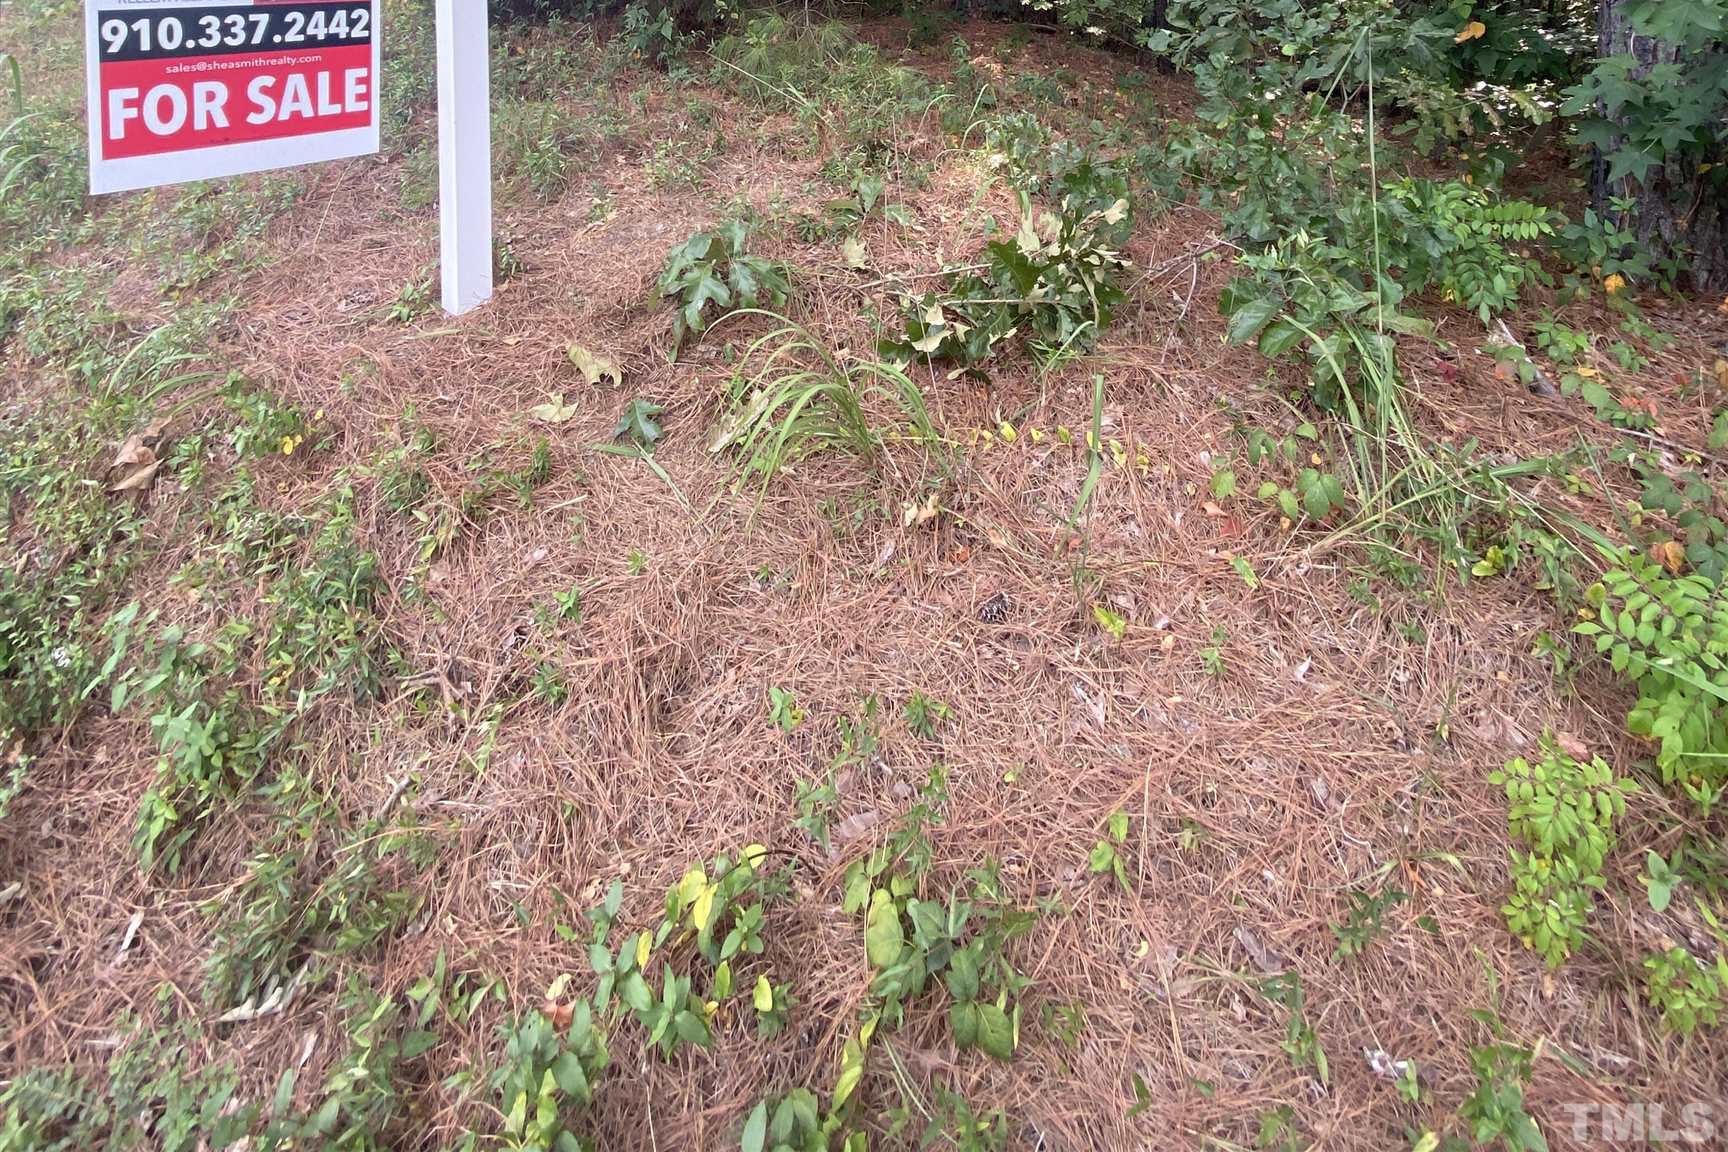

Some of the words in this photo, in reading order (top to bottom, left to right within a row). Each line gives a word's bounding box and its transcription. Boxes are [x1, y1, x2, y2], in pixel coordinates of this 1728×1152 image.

[101, 8, 370, 53] 910.337.2442
[165, 53, 322, 74] sales@sheasmithrealty.com
[108, 80, 230, 141] FOR
[246, 67, 369, 126] SALE
